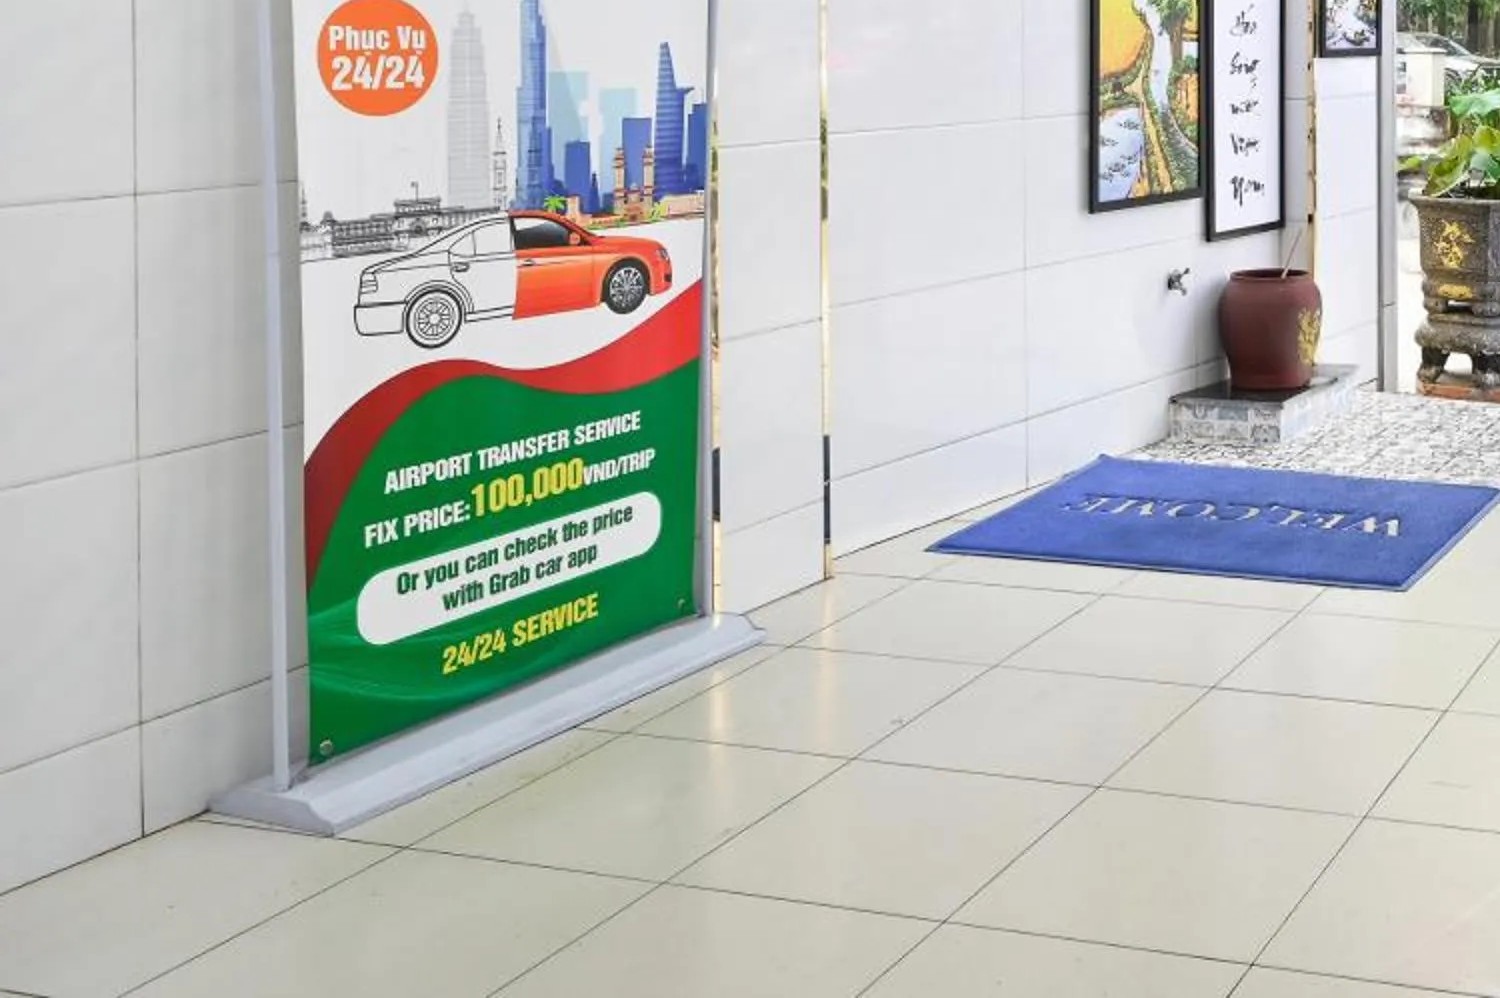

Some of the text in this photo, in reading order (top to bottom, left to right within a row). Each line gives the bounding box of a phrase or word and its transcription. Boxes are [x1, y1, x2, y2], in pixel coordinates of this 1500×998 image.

[329, 25, 426, 56] Phục Vụ
[331, 54, 425, 90] 24/24
[384, 410, 641, 495] AIRPORT TRANSFER SERVICE
[364, 518, 399, 548] FIX
[1062, 495, 1401, 537] WELCOME
[396, 505, 634, 595] Or you can check the price
[443, 544, 598, 611] with Grab car app
[442, 593, 599, 675] 24/24 SERVICE
